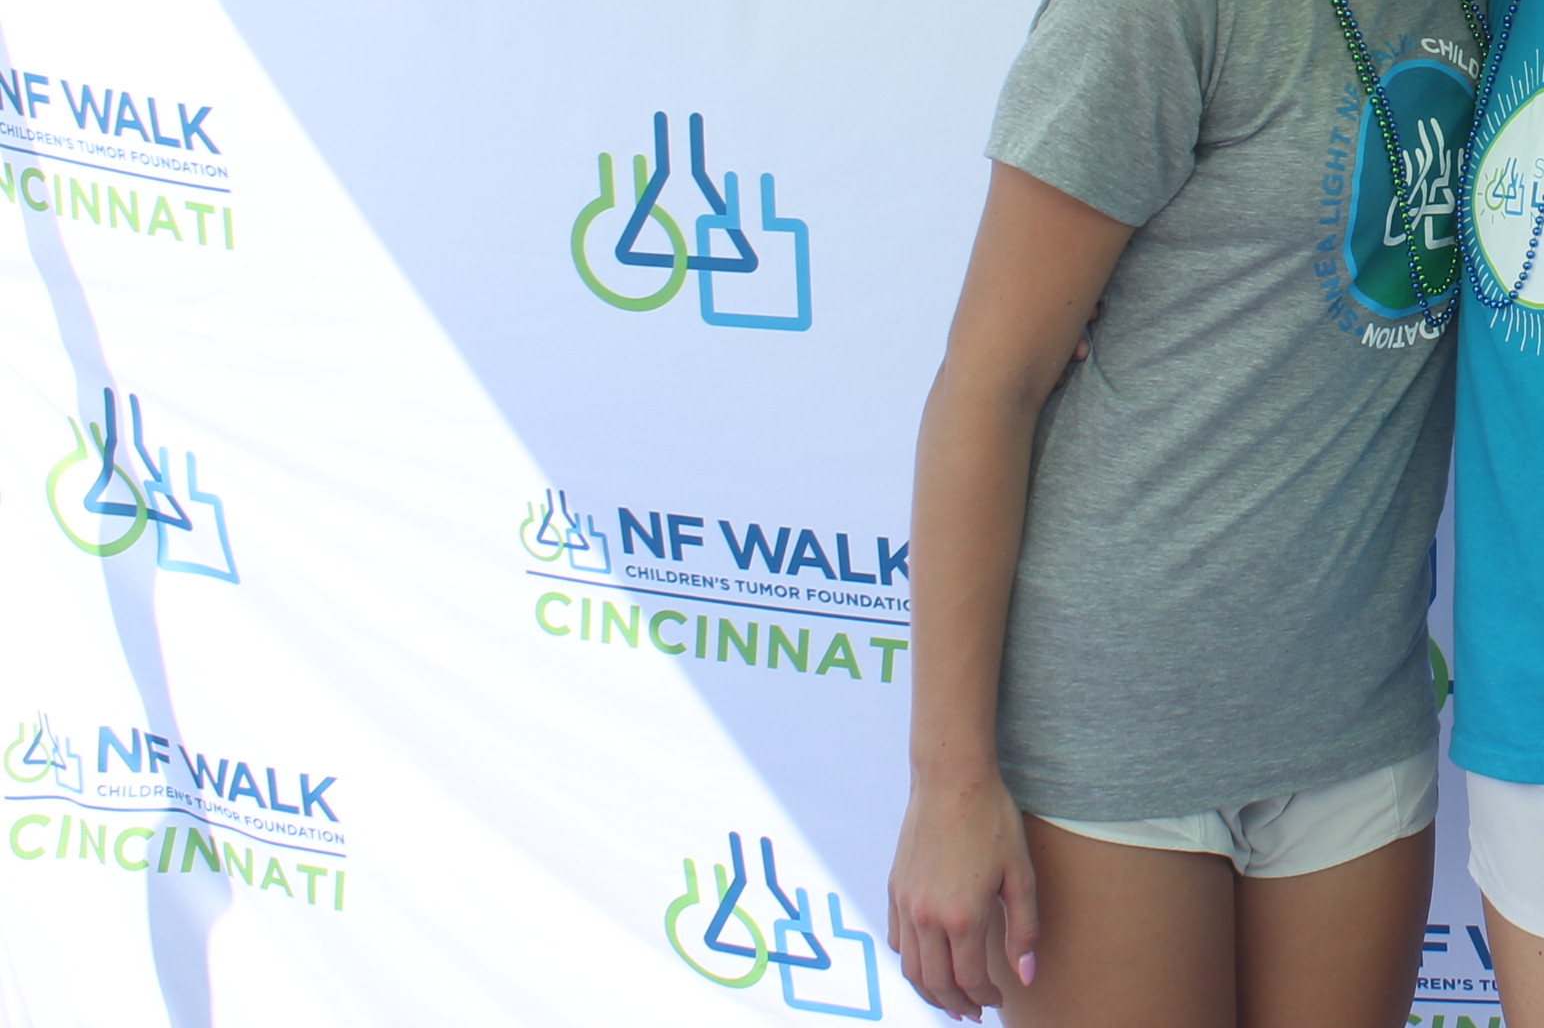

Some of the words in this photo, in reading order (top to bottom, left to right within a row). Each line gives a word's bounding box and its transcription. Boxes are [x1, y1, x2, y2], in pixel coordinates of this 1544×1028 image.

[1421, 38, 1479, 79] CHILD
[0, 68, 50, 119] NF
[60, 79, 222, 155] WALK
[77, 140, 126, 161] TUMOR
[130, 150, 229, 179] FOUNDATION
[1318, 126, 1352, 224] LIGHT
[617, 507, 704, 561] NF
[717, 520, 910, 586] WALK
[625, 565, 730, 592] CHILDREN'S
[737, 579, 801, 601] TUMOR
[806, 587, 910, 613] FOUNDATIO
[535, 591, 909, 684] CINCINNAT
[97, 726, 170, 774] NF
[178, 743, 339, 823] WALK
[97, 784, 192, 806] CHILDREN'S
[195, 797, 241, 822] TUMOR
[244, 815, 346, 845] FOUNDATION
[9, 814, 345, 911] CINCINNATI
[1417, 978, 1473, 991] REN'S
